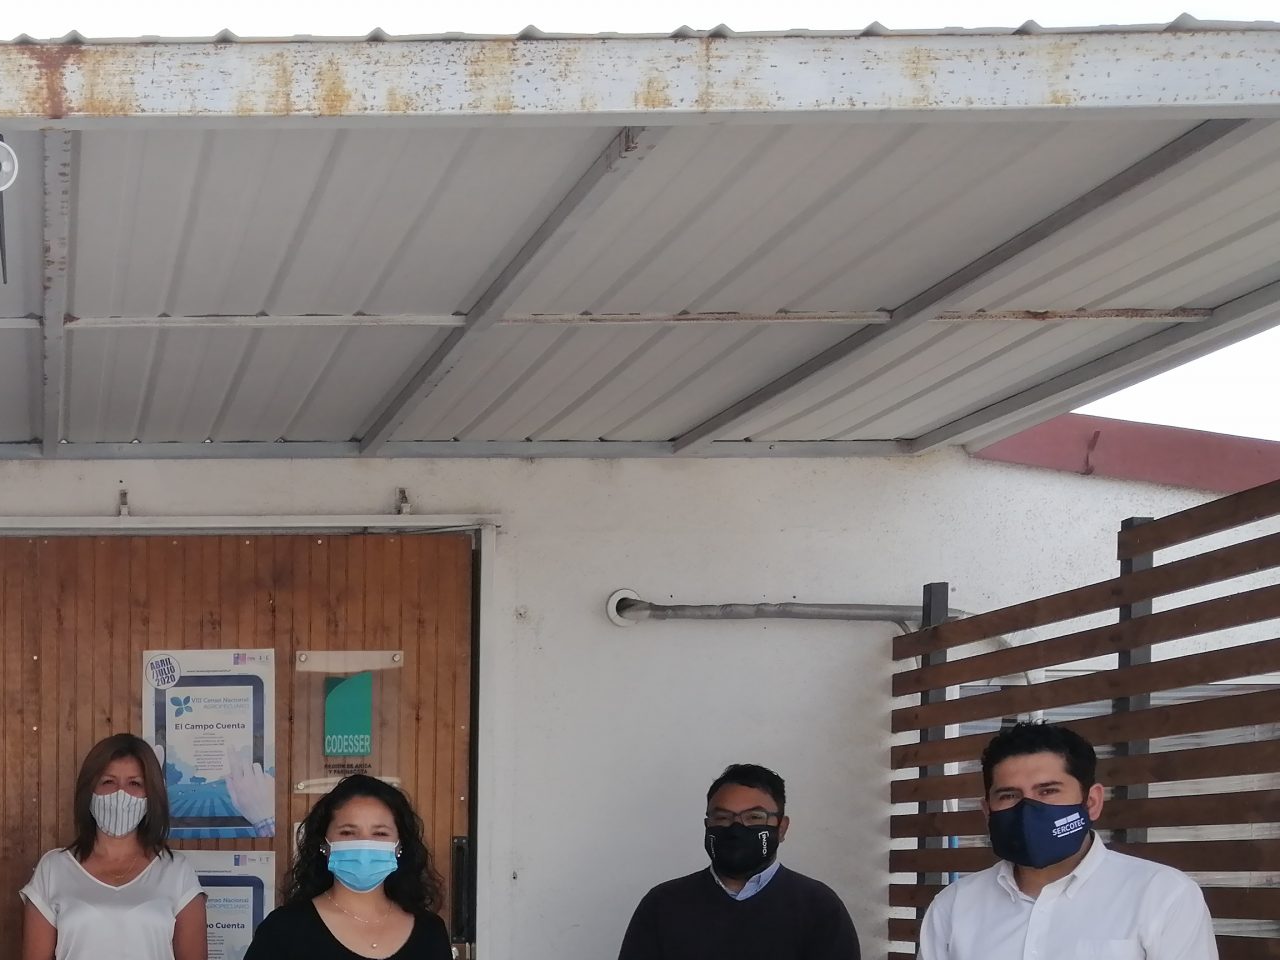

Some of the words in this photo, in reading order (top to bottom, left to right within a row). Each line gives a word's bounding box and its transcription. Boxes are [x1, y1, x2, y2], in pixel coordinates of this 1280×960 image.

[150, 658, 172, 671] ABRIL
[155, 675, 176, 686] 2020
[184, 722, 214, 732] Campo
[215, 722, 246, 730] Cuenta
[325, 734, 371, 753] CODESSER
[1052, 817, 1086, 836] SERCOTEC
